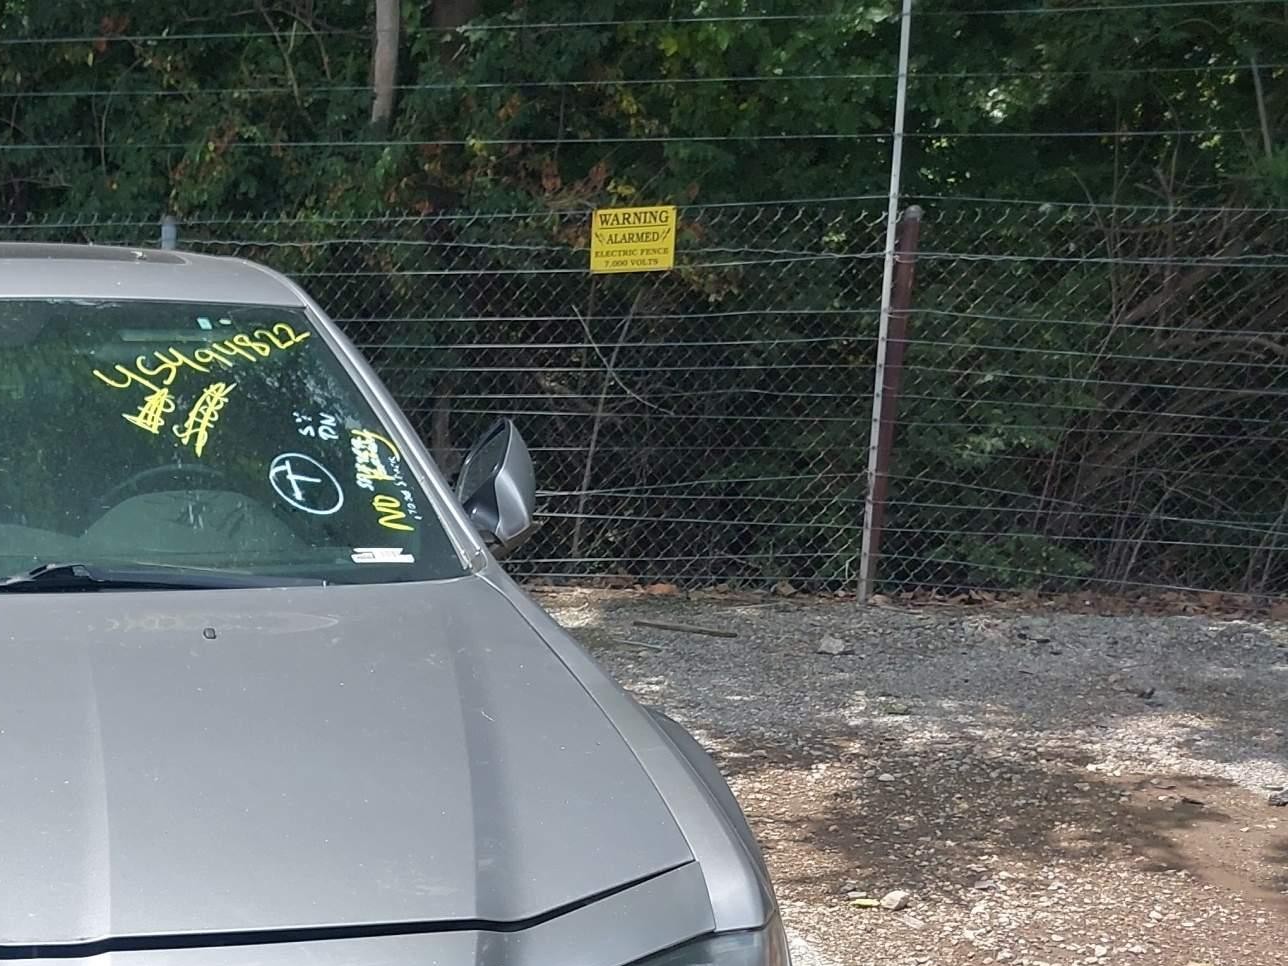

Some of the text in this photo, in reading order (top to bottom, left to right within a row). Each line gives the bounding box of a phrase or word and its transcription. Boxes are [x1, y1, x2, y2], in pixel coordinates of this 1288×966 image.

[599, 210, 669, 226] WARNING
[606, 231, 660, 244] ALARMED
[594, 248, 669, 258] ELECTRIC FENCE
[604, 258, 658, 268] 7,000 VOLTS
